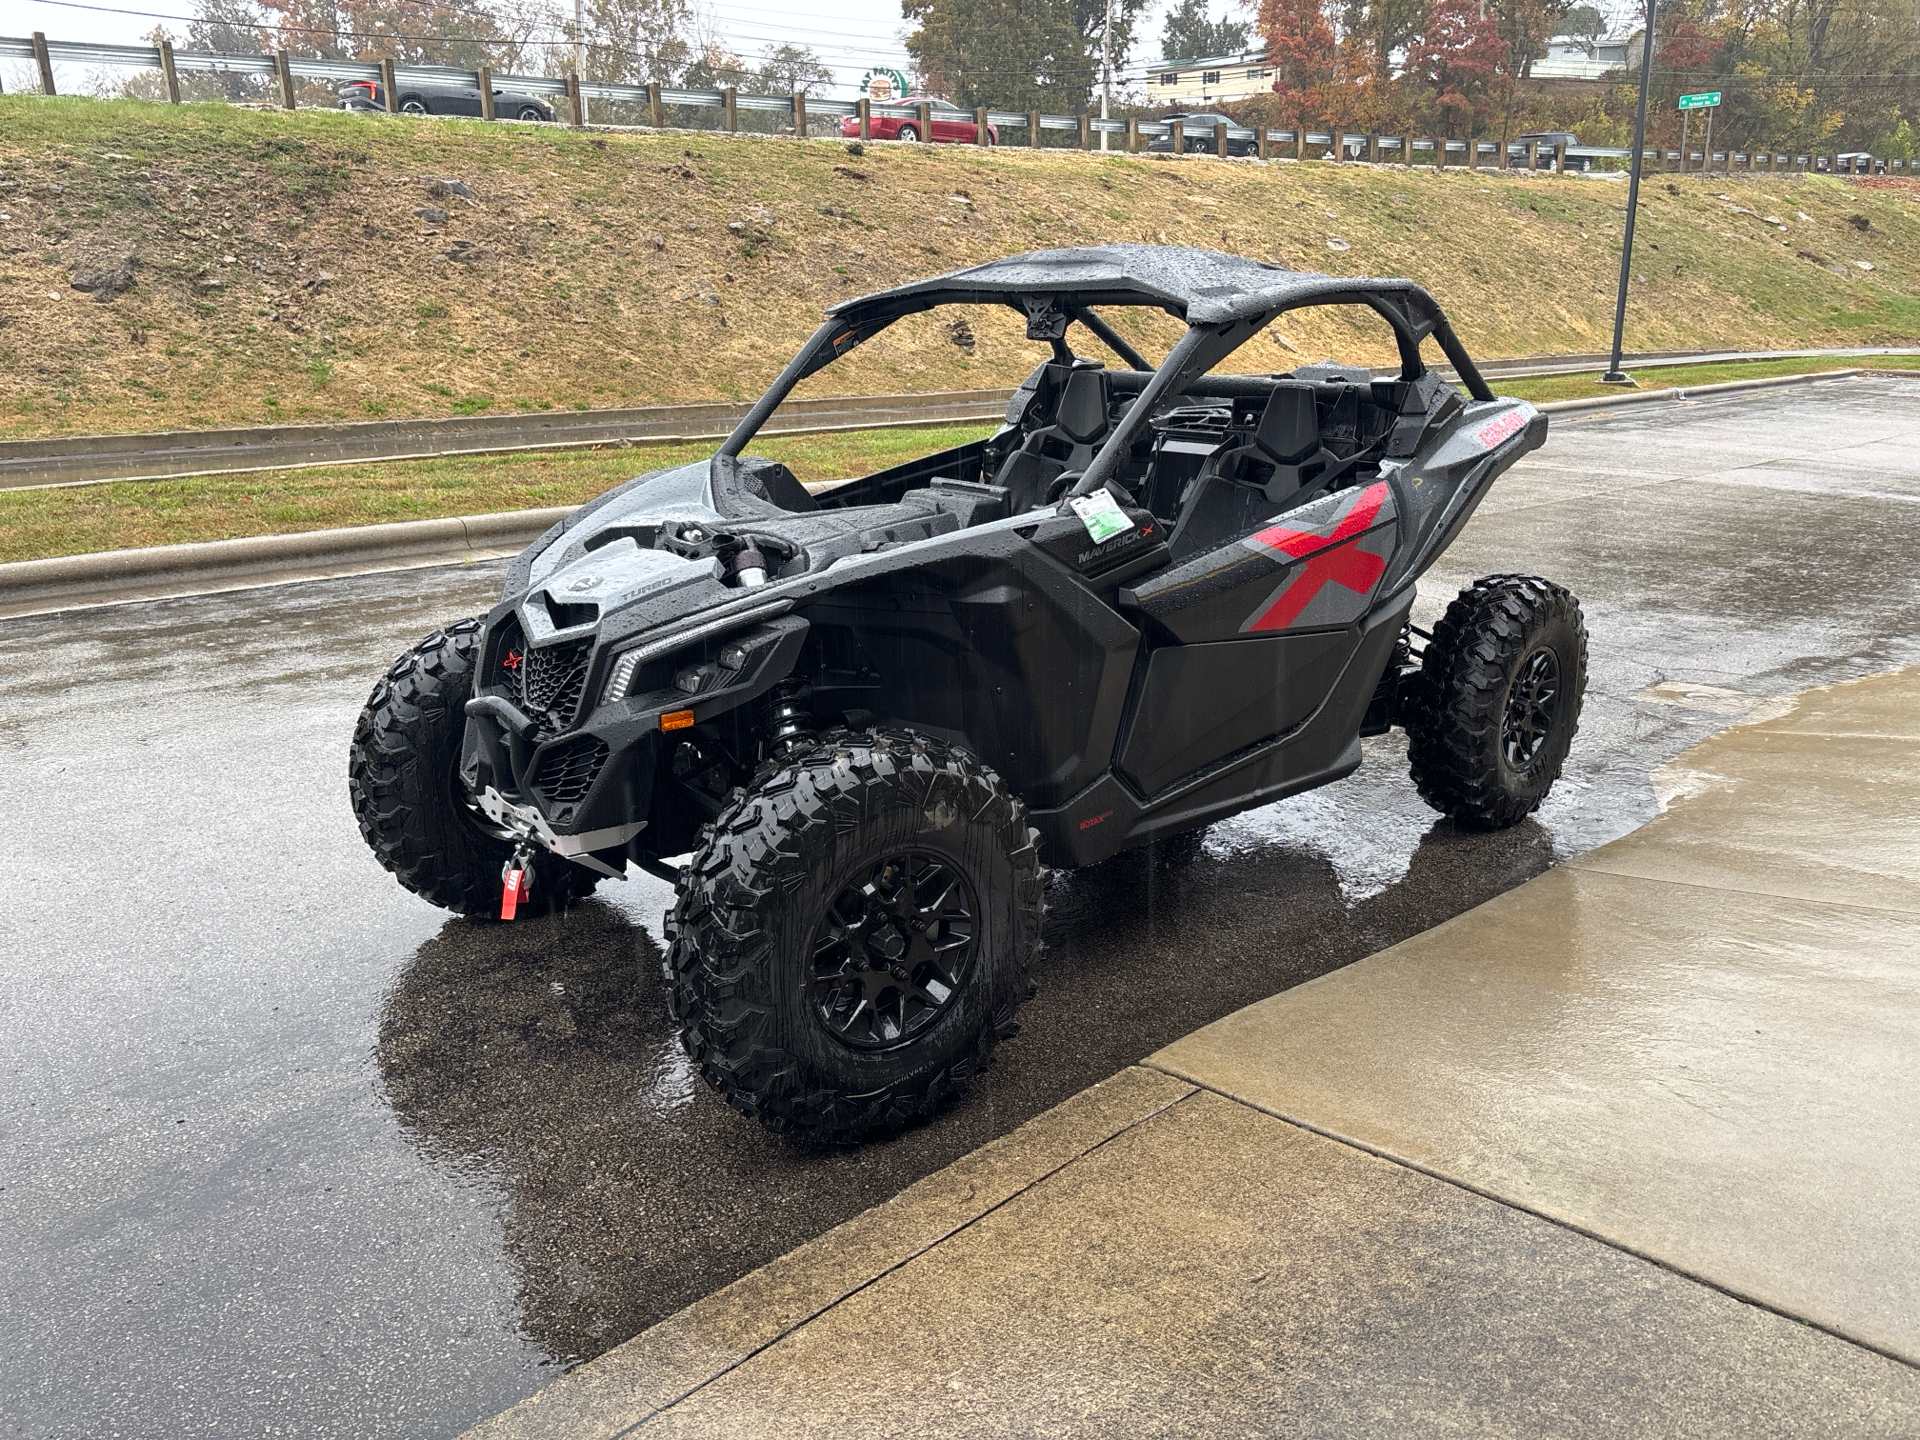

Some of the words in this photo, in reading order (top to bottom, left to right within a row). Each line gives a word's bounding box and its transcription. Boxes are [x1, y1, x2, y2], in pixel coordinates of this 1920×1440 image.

[1077, 528, 1142, 565] MAVERICK
[620, 576, 673, 601] TURBO
[1079, 814, 1104, 831] ROTAX
